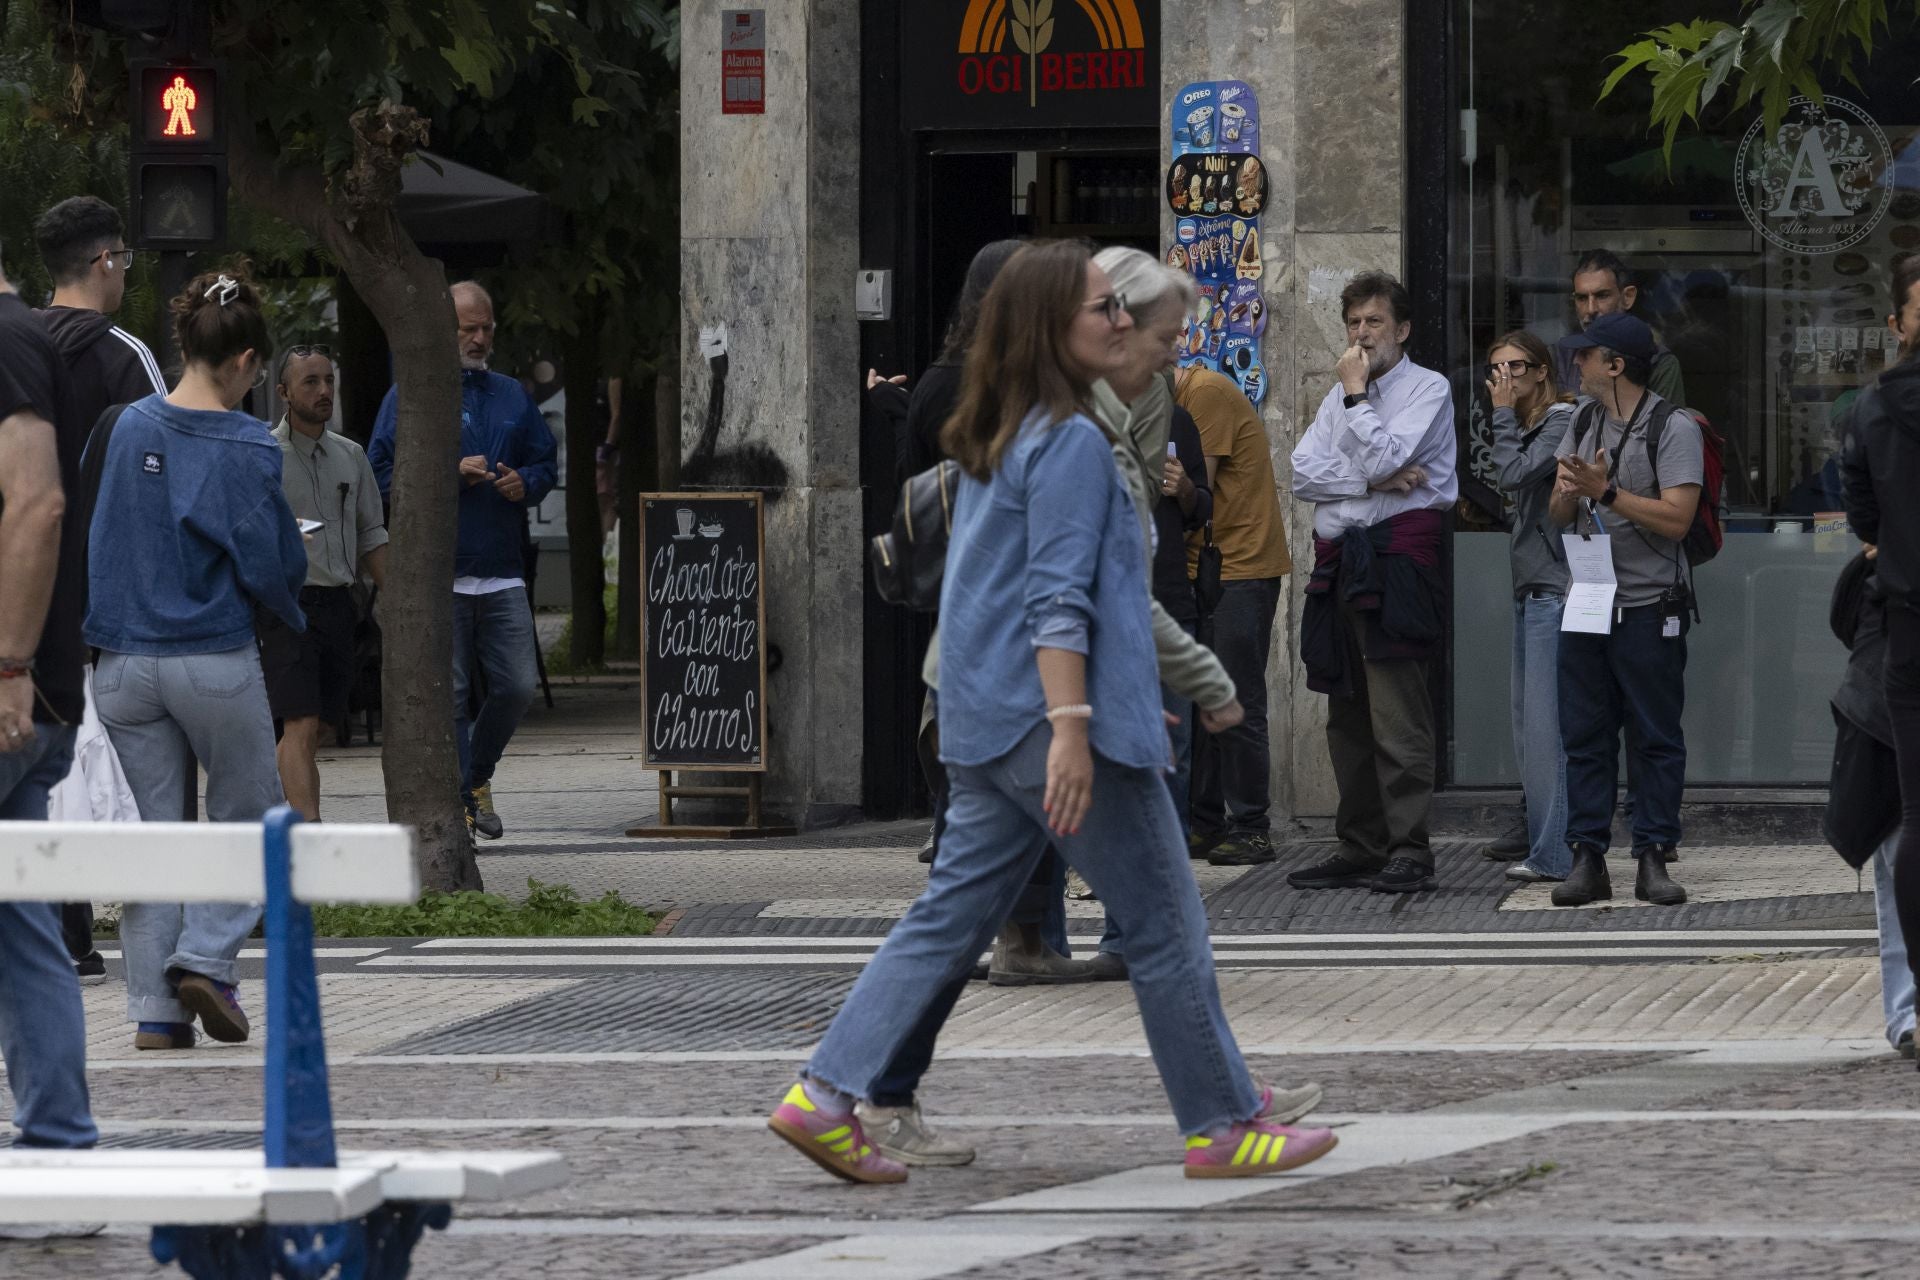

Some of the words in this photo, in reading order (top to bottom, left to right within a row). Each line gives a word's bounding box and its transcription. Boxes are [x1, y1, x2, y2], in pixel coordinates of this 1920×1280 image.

[726, 54, 761, 67] Alarma
[958, 54, 1022, 95] OGI
[1040, 50, 1145, 92] BERRI
[1183, 89, 1211, 106] OREO
[1220, 86, 1242, 103] Milka
[1768, 125, 1855, 217] A
[1774, 220, 1824, 235] Altuna
[1827, 223, 1856, 235] 1933
[1237, 283, 1256, 297] Milka
[1226, 337, 1251, 348] OREO
[649, 543, 757, 605] Chocolate
[659, 604, 756, 662] Caliente
